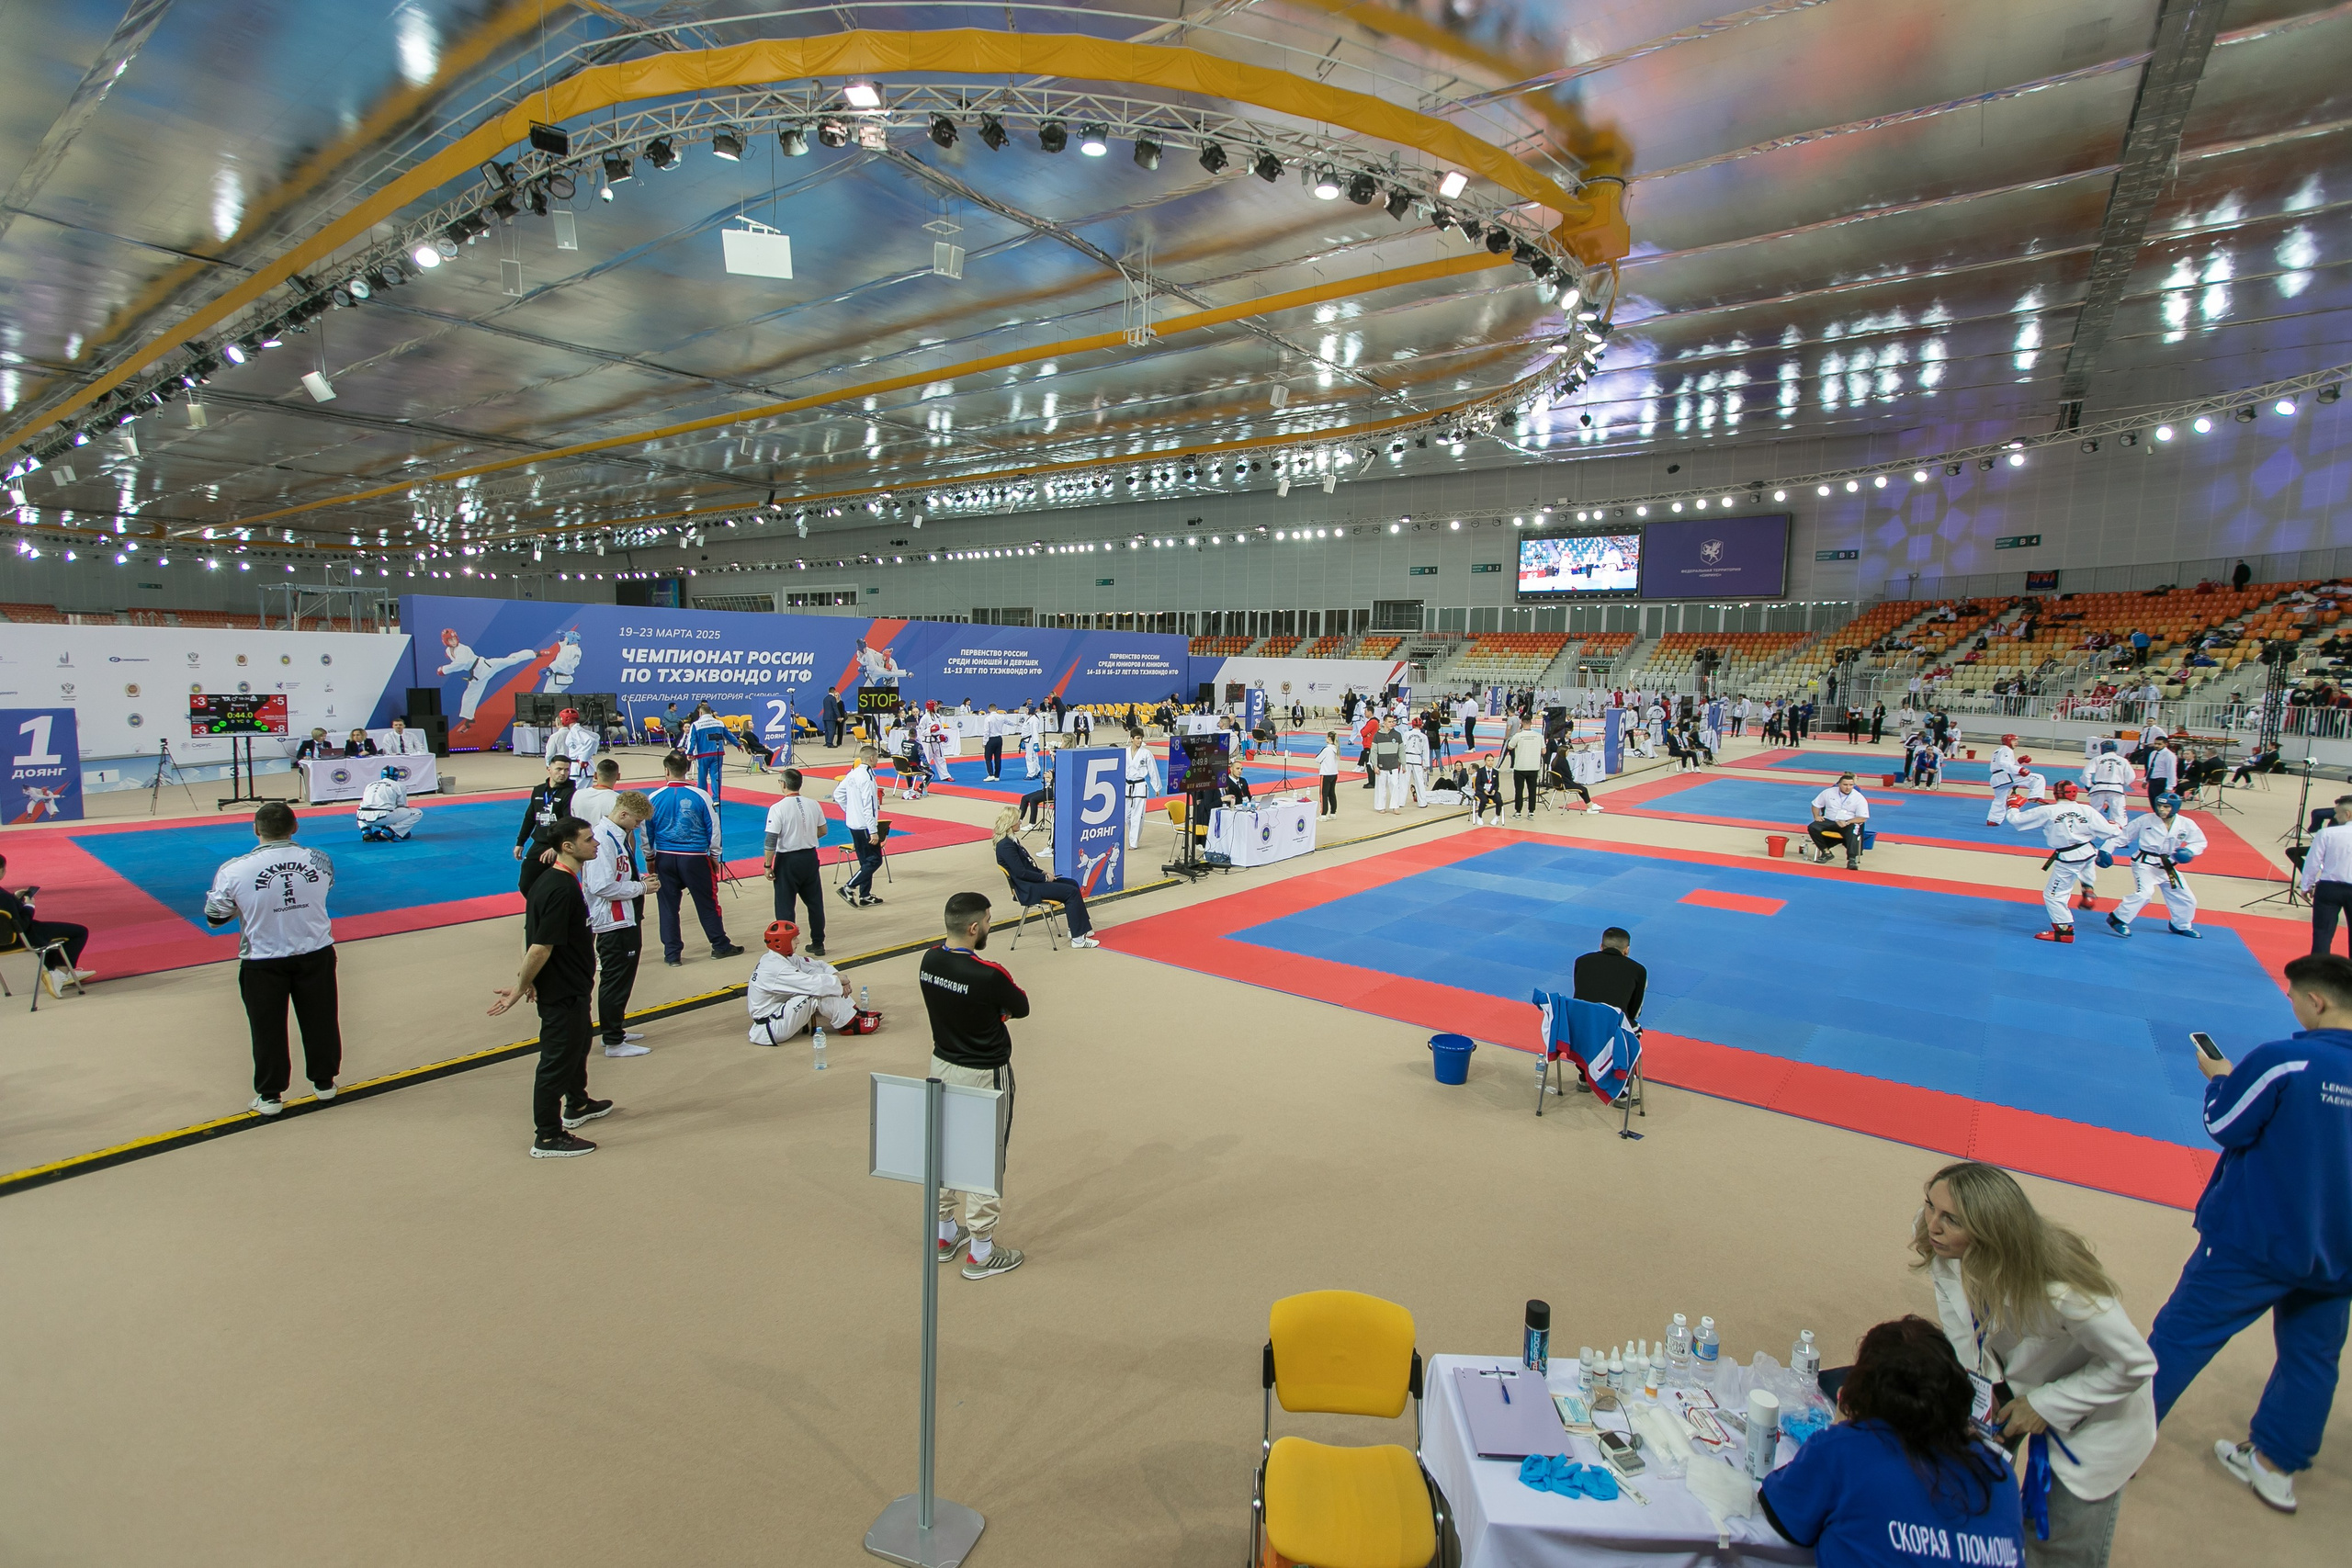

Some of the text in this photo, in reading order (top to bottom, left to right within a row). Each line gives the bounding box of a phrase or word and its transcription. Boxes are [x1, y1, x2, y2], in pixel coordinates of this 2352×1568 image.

[656, 628, 693, 639] МАРТА
[695, 629, 721, 639] 2025
[621, 648, 815, 666] ЧЕМПИОНАТ РОССИИ
[960, 649, 1028, 658] ПЕРВЕНСТВО РОССИИ
[948, 657, 1039, 668] СРЕДИ ЮНОШЕЙ И ДЕВУШЕК
[620, 668, 813, 686] ПО ТХЭКВОНДО ИТФ
[989, 668, 1028, 676] ТХЭКВОНДО
[1029, 668, 1043, 676] ИТФ
[621, 693, 689, 703] ФЕДЕРАЛЬНАЯ
[691, 693, 744, 702] ТЕРРИТОРИЯ
[1253, 690, 1263, 711] 3
[1403, 688, 1411, 705] 4
[1497, 687, 1502, 702] 8
[192, 696, 207, 706] +3
[273, 696, 285, 706] +5
[858, 694, 899, 708] STOP
[764, 699, 787, 733] 2
[1718, 704, 1724, 726] 7
[194, 726, 208, 735] +3
[273, 724, 286, 733] +8
[1618, 712, 1626, 742] 6
[13, 716, 62, 766] 1
[764, 733, 786, 741] ДОЯНГ
[1221, 736, 1228, 748] +4
[1171, 739, 1180, 750] +8
[1191, 757, 1208, 767] 0:49.8
[11, 768, 67, 780] ДОЯНГ
[98, 772, 105, 783] 1
[1218, 773, 1227, 784] +6
[1170, 778, 1179, 790] +5
[1080, 758, 1119, 825] 5
[1080, 826, 1117, 842] ДОЯНГ
[254, 862, 320, 891] TAEKWON-DO
[280, 873, 296, 907] TEAM
[273, 903, 311, 913] NOVOSIBIRSK
[933, 976, 969, 995] МОСКВИЧ
[1888, 1520, 1951, 1559] СКОРАЯ
